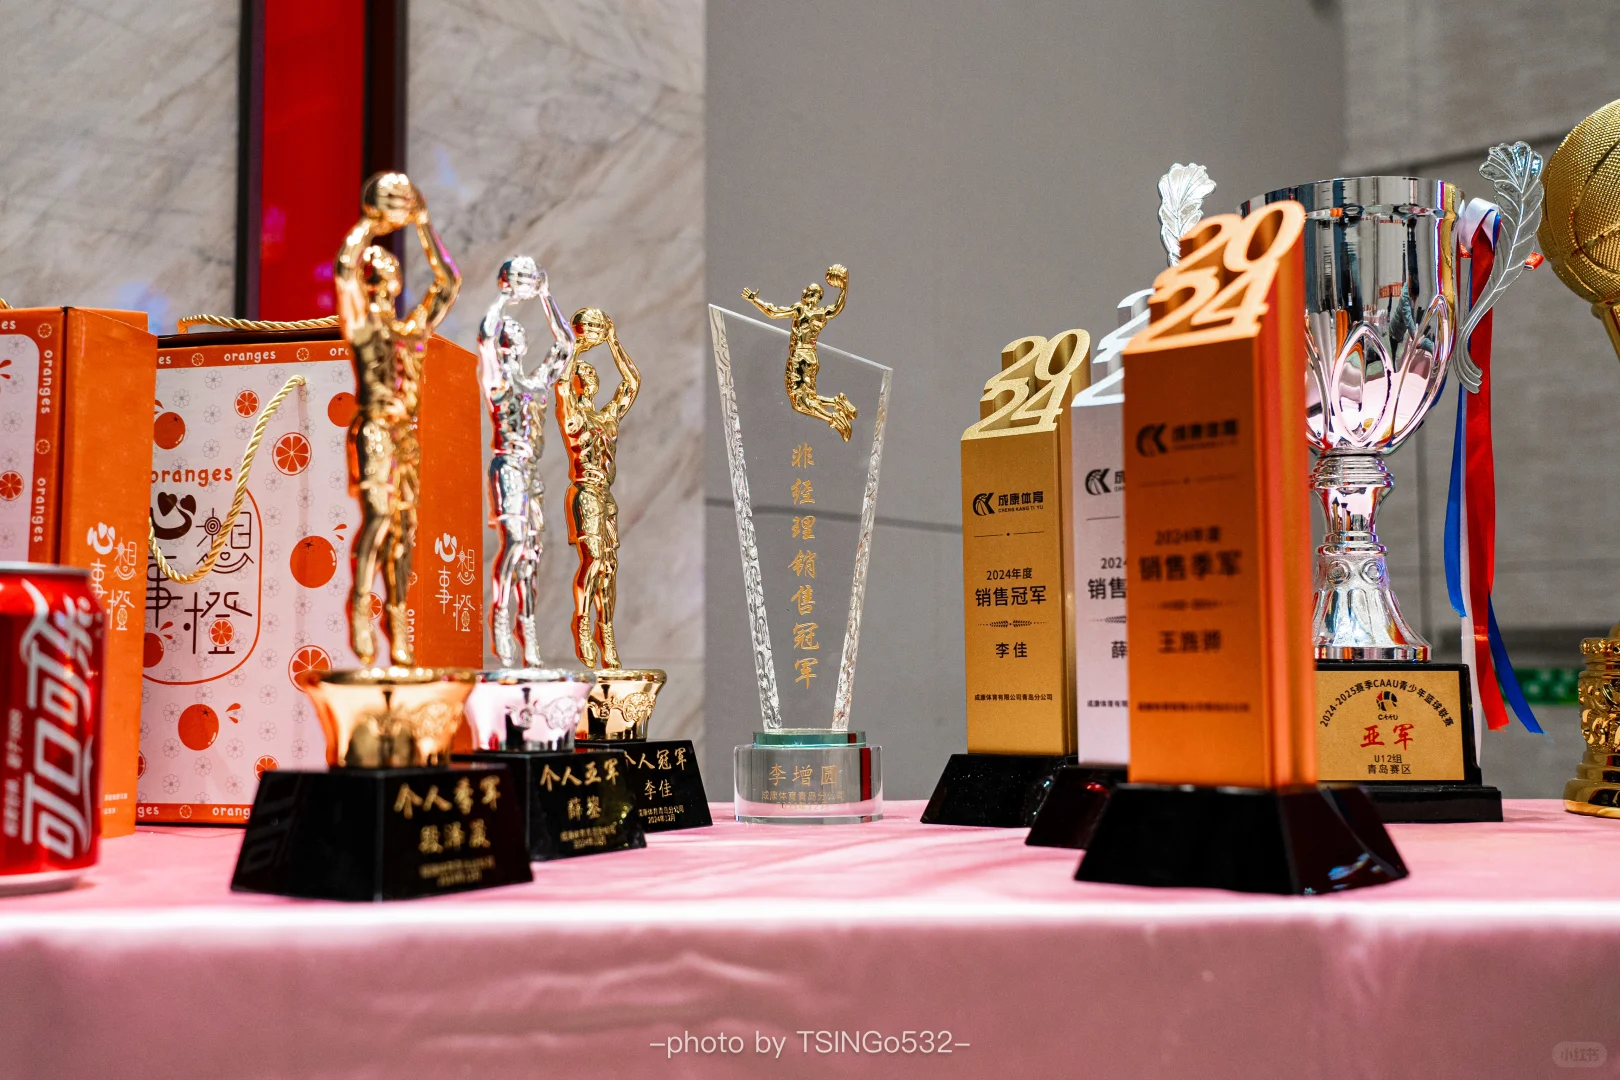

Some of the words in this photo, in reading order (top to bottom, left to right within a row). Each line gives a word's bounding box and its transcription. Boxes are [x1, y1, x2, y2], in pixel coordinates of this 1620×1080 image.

[224, 350, 276, 363] oranges
[984, 329, 1091, 391] 20
[39, 350, 53, 414] oranges
[961, 373, 1071, 440] 24
[151, 467, 233, 488] oranges
[998, 490, 1044, 506] 成康体育
[31, 477, 46, 543] oranges
[986, 567, 1032, 580] 2024年度
[1100, 557, 1127, 570] 202
[975, 585, 1046, 607] 销售冠军
[995, 641, 1027, 658] 李佳
[974, 693, 1053, 701] 成康体育有限公司青岛分公司
[1360, 723, 1414, 751] 亚军
[1367, 764, 1411, 775] 青岛赛区
[1374, 754, 1403, 764] U12组
[539, 757, 620, 792] 个人亚军
[644, 778, 673, 800] 李佳
